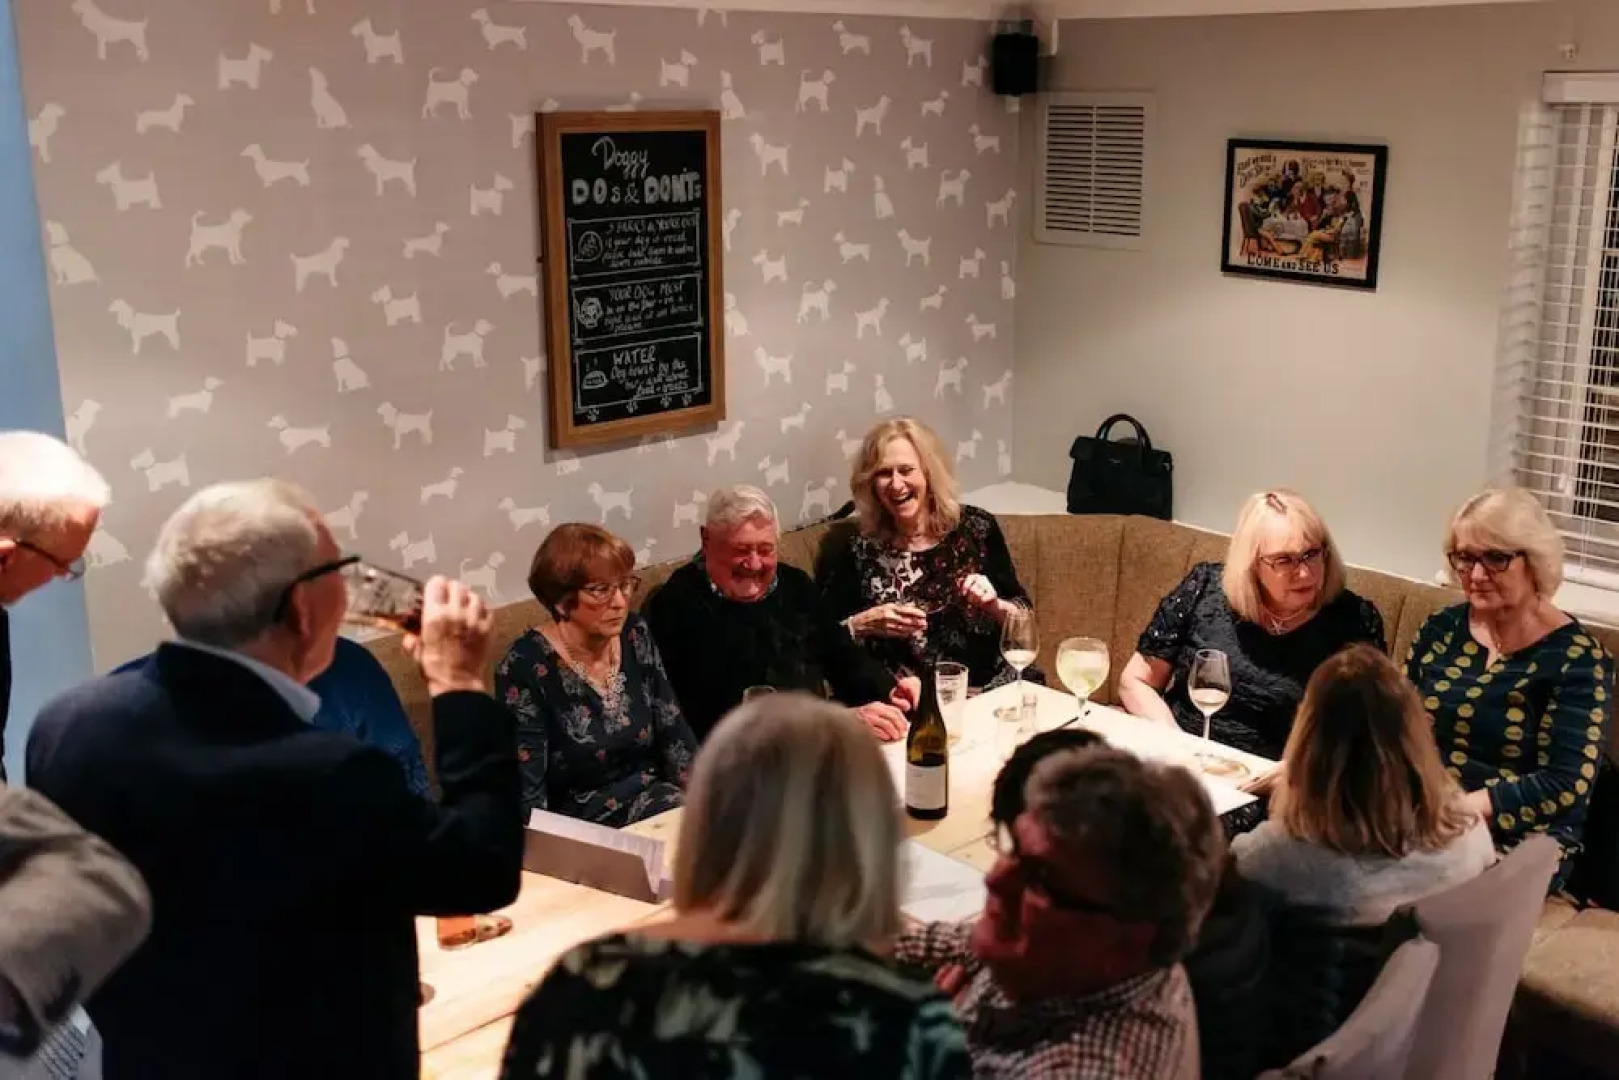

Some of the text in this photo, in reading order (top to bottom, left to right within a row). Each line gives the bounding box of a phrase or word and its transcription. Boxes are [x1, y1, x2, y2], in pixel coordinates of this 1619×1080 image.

[591, 136, 651, 179] Doggy
[624, 182, 640, 204] &
[613, 345, 656, 365] WATER
